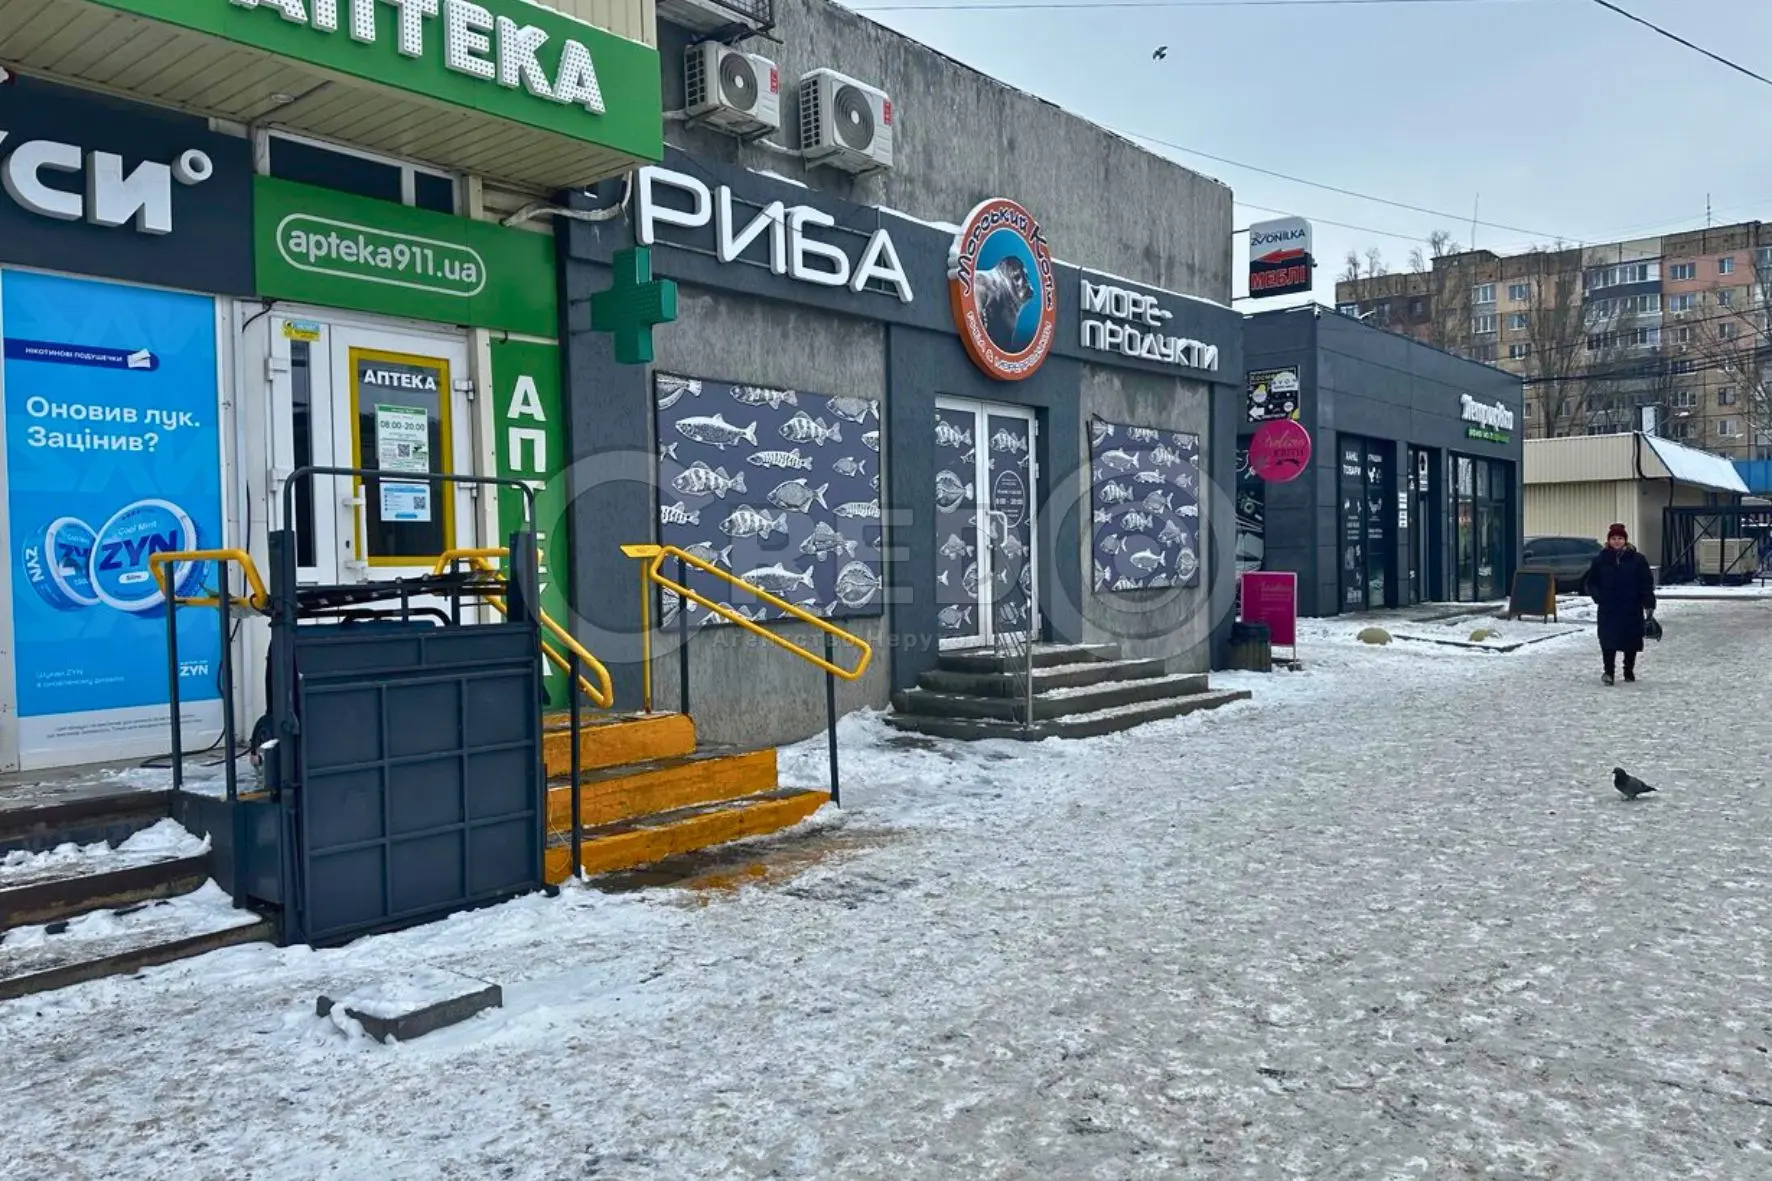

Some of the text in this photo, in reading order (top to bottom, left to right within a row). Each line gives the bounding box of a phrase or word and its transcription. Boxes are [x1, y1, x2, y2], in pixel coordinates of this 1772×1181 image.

[229, 0, 607, 115] ТЕКА
[636, 165, 914, 303] РИБА
[288, 229, 477, 283] apteka911.ua
[1251, 265, 1306, 290] МЕБЛІ
[1080, 279, 1173, 326] МОРЕ-
[25, 347, 73, 358] НІКОТИНОВІ
[1080, 319, 1219, 371] ПРОДУКТИ
[363, 369, 437, 391] АПТЕКА
[26, 395, 200, 431] Оновив лук.
[27, 425, 160, 453] Зацінив?
[25, 546, 45, 582] ZYN
[180, 664, 208, 677] ZYN
